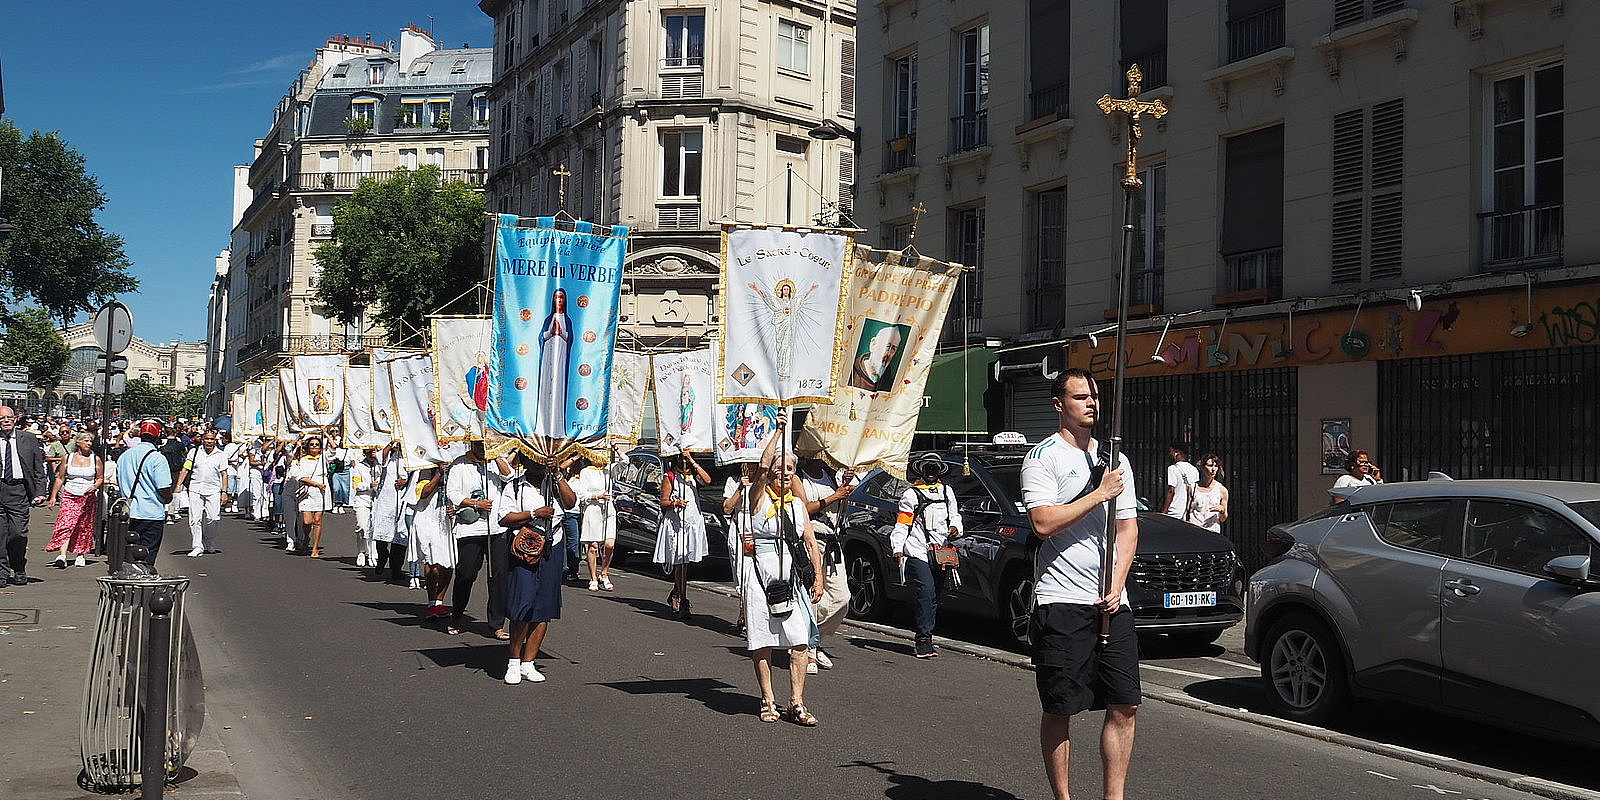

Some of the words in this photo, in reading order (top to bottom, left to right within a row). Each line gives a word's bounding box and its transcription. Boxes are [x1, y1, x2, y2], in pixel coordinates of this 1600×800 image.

[561, 236, 571, 246] de
[737, 254, 751, 267] Le
[503, 255, 547, 277] MÈRE
[551, 262, 566, 278] du
[570, 263, 617, 284] VERBE
[855, 268, 898, 284] GROUPE
[798, 379, 823, 389] 1873
[497, 417, 520, 428] Paris
[1170, 593, 1211, 606] GD-191-RK
